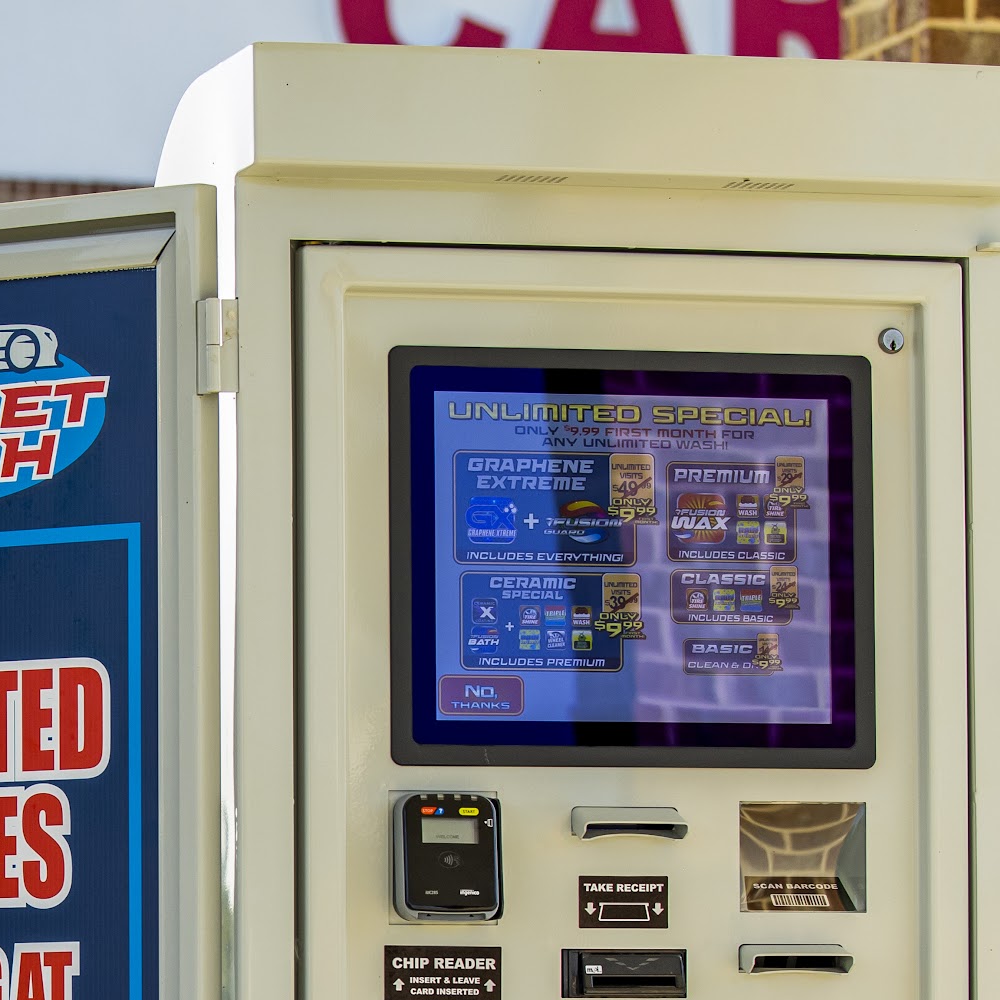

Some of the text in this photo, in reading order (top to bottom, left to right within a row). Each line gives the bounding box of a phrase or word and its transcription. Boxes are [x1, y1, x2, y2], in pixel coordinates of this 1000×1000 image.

[448, 401, 812, 427] UNLIMITED SPECIAL!
[515, 425, 755, 440] ONLY $9.99 FIRST MONTH FOR
[542, 437, 728, 450] ANY UNLIMITED WASH!
[467, 458, 594, 474] GRAPHENE
[612, 463, 651, 471] UNLIMITED
[619, 472, 644, 480] VISITS
[673, 468, 770, 484] PREMIUM
[476, 476, 586, 491] EXTREME
[612, 498, 651, 506] ONLY
[671, 516, 731, 530] WAX
[467, 529, 517, 537] GRAPHENE XTREME
[467, 551, 623, 562] INCLUDES EVERYTHING!
[679, 551, 786, 560] INCLUDES CLASSIC
[490, 576, 576, 590] CERAMIC
[681, 573, 766, 586] CLASSIC
[502, 590, 564, 600] SPECIAL
[480, 606, 496, 619] X
[600, 612, 639, 620] ONLY
[692, 644, 753, 654] BASIC
[479, 658, 605, 667] INCLUDES PREMIUM
[451, 701, 510, 710] THANKS
[584, 883, 664, 892] TAKE RECEIPT
[392, 957, 496, 970] CHIP READER
[410, 976, 441, 984] INSERT
[453, 977, 481, 985] LEAVE
[436, 988, 480, 996] INSERTED
